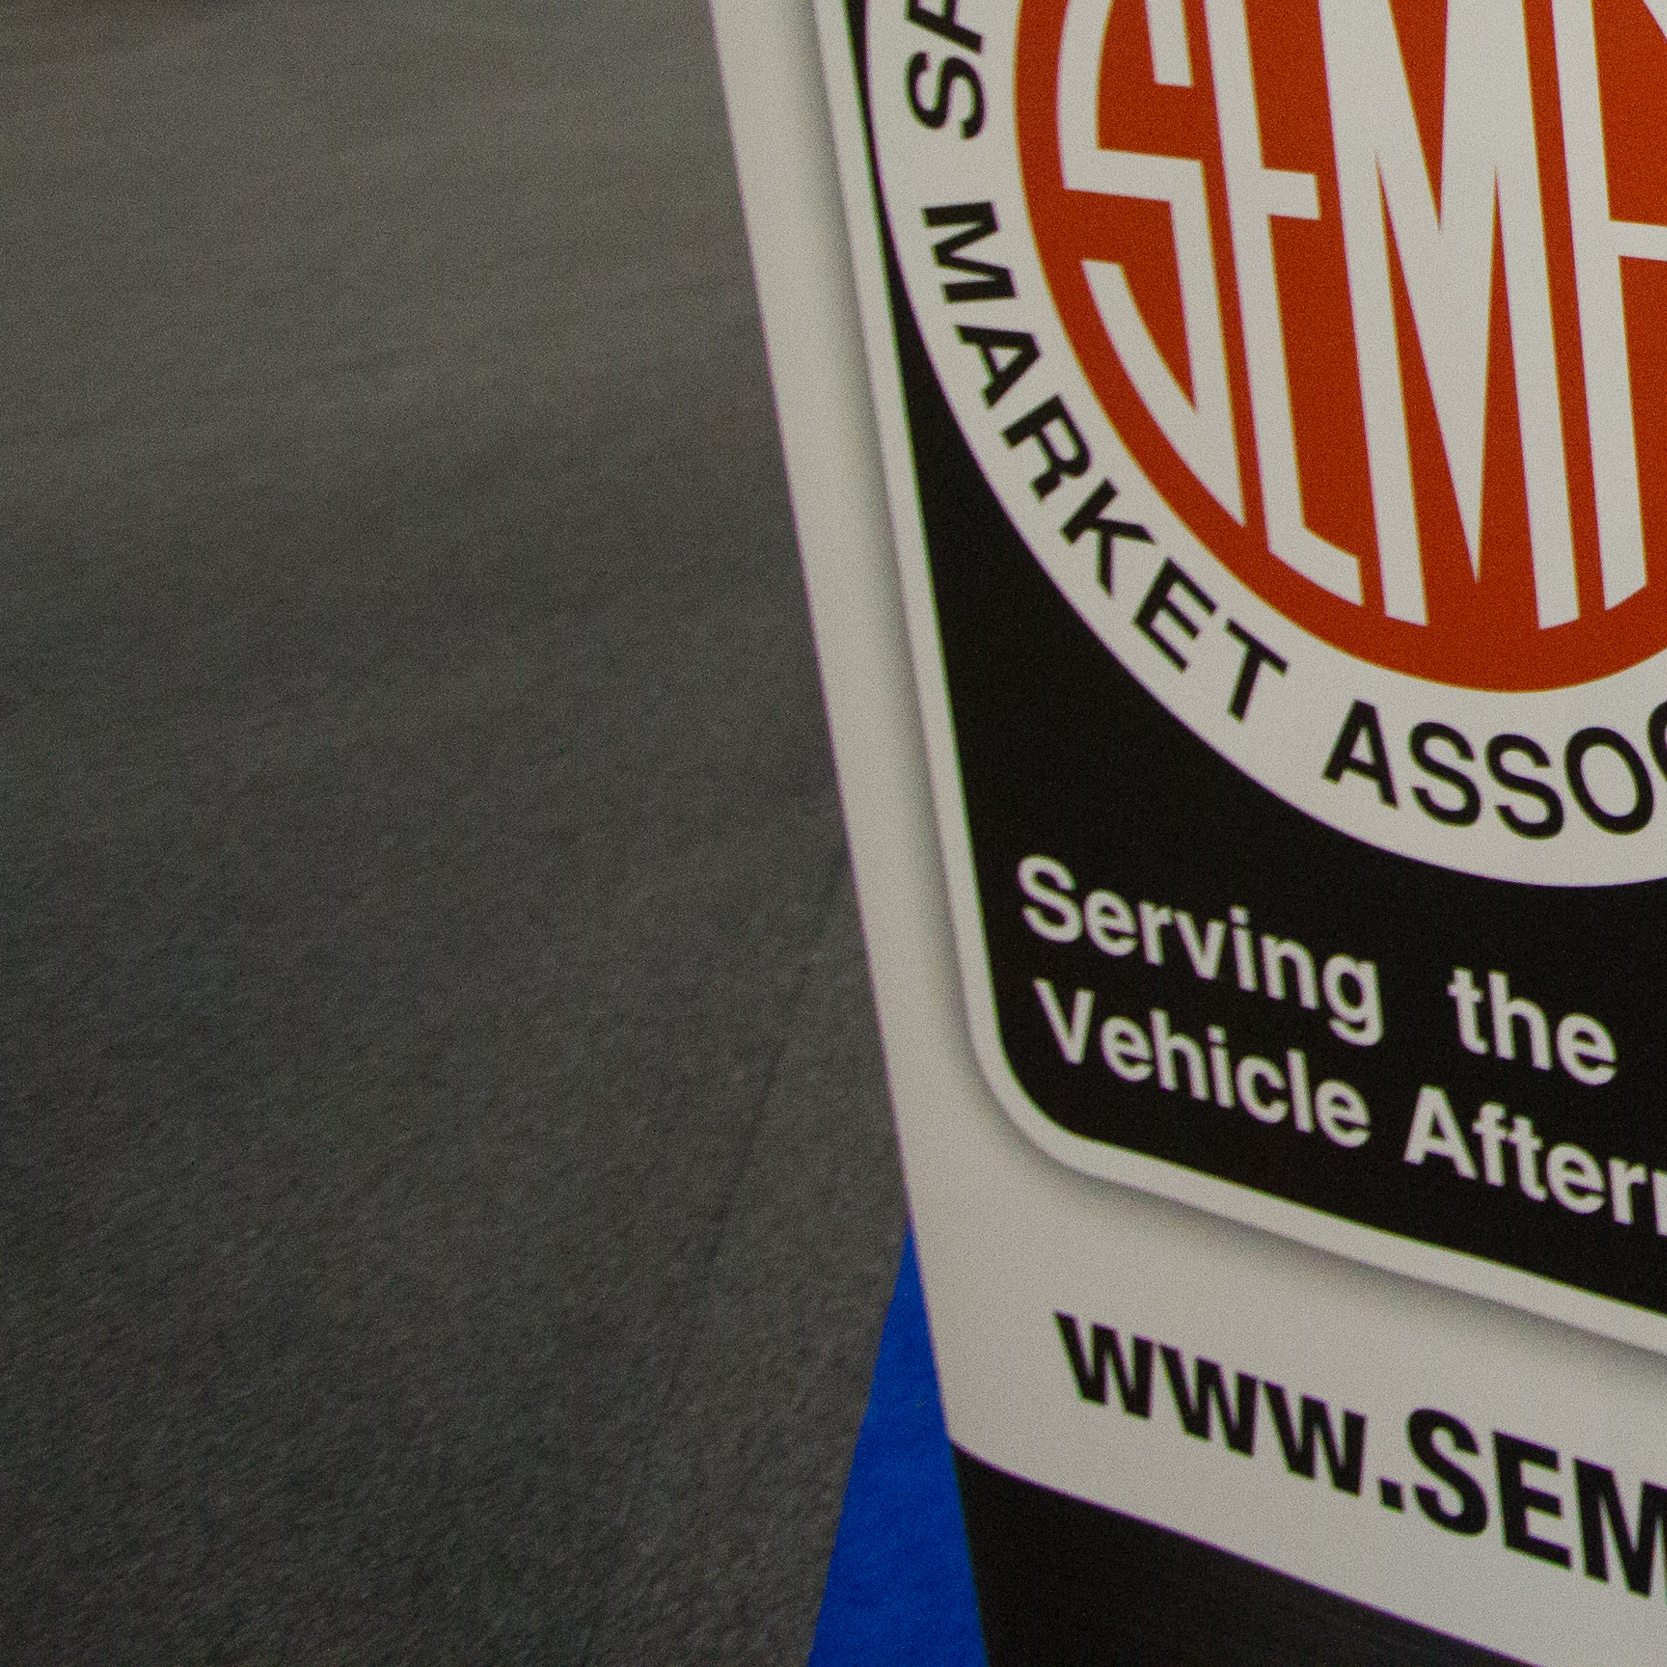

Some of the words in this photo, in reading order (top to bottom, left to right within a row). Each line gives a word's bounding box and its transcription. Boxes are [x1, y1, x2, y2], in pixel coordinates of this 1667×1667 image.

[922, 201, 1289, 721] MARKET
[1016, 853, 1385, 1047] Serving
[1446, 966, 1618, 1087] the
[1033, 978, 1371, 1149] Vehicle
